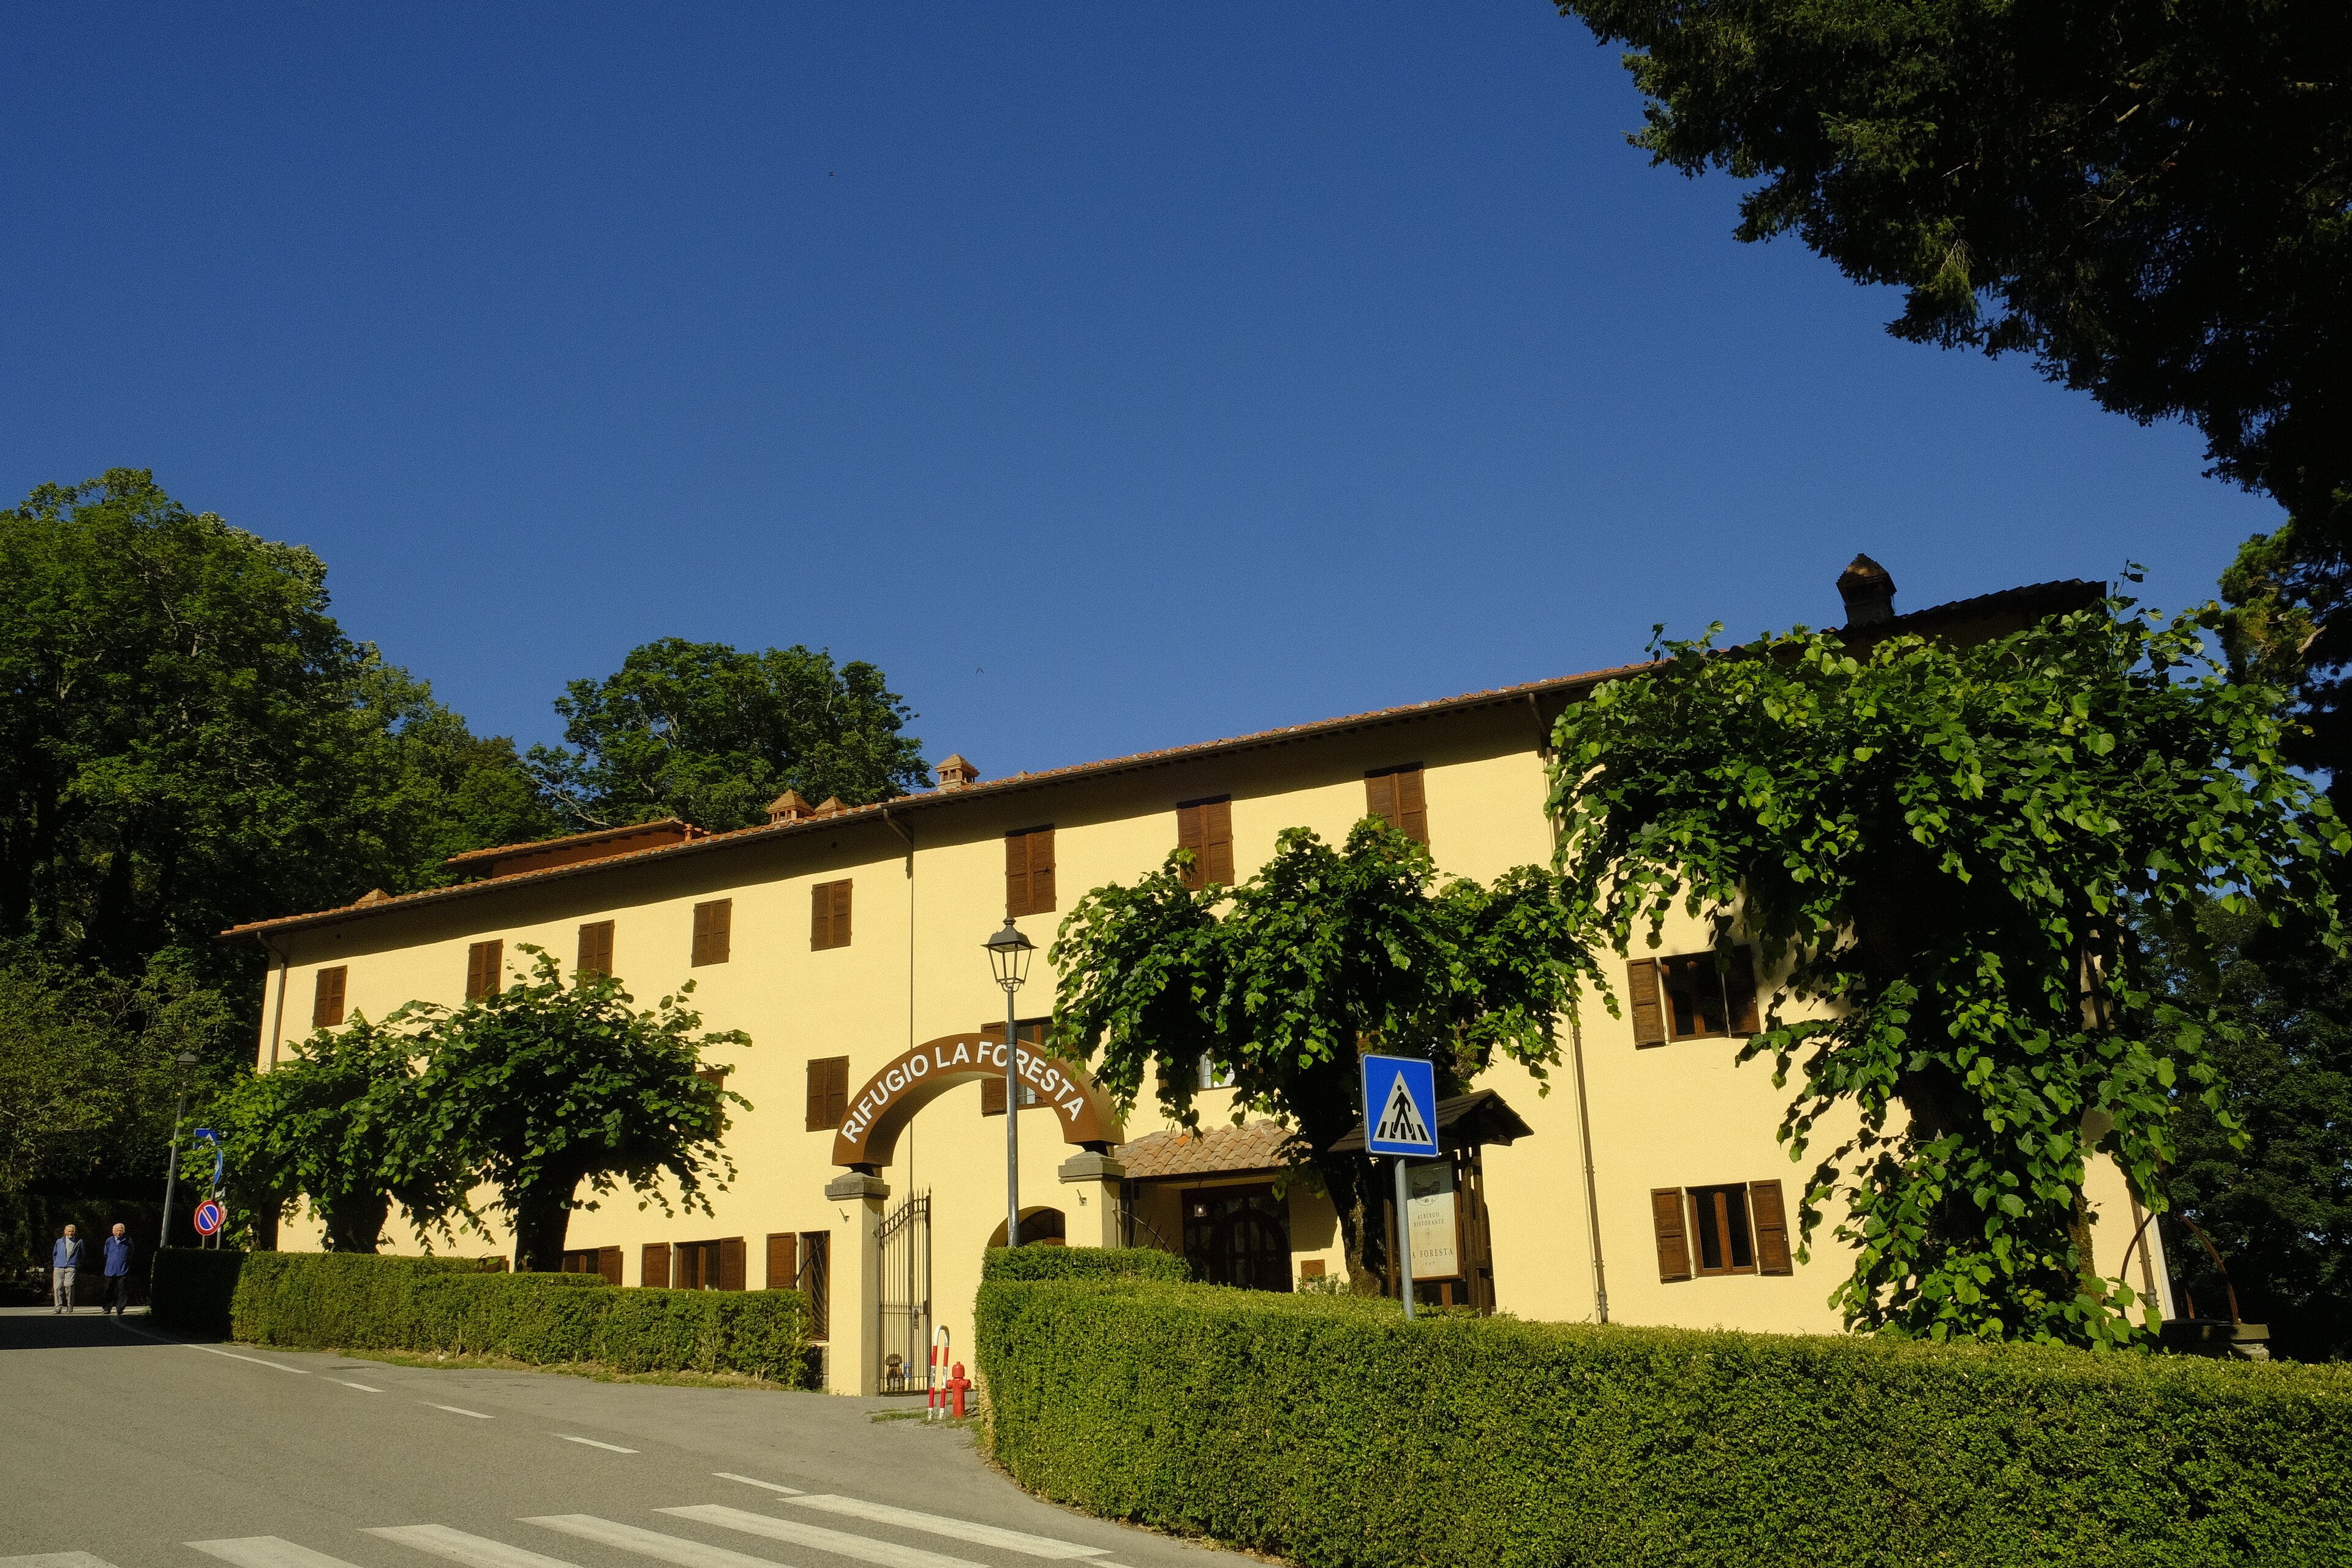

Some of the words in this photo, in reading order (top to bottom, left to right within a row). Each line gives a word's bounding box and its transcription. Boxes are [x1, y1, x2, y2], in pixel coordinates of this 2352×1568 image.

[841, 1054, 929, 1144] RIFUGIO
[935, 1042, 970, 1069] LA
[976, 1041, 1084, 1122] FORESTA
[1420, 1248, 1453, 1258] FORESTA
